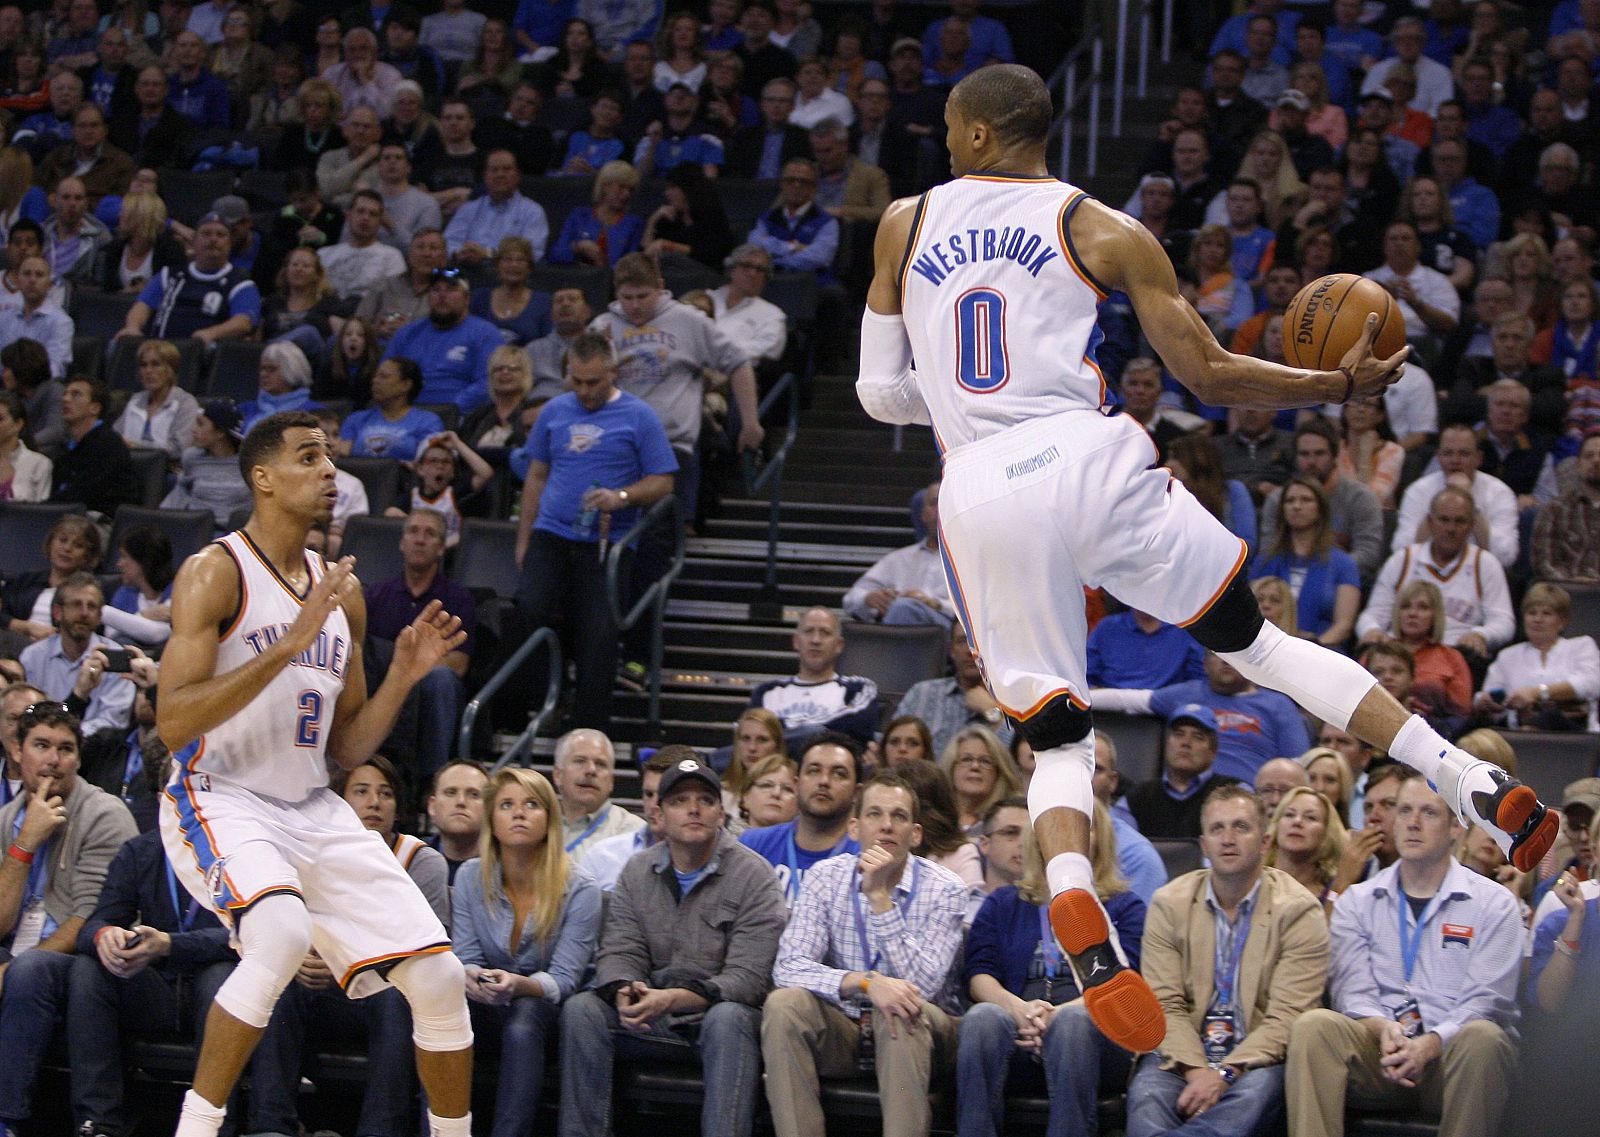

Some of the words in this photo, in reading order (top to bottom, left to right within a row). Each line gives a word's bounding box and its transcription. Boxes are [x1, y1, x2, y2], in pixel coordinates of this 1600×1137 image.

[911, 225, 1059, 287] WESTBROOK
[954, 286, 1011, 394] 0
[241, 622, 350, 684] THDE
[294, 688, 324, 748] 2
